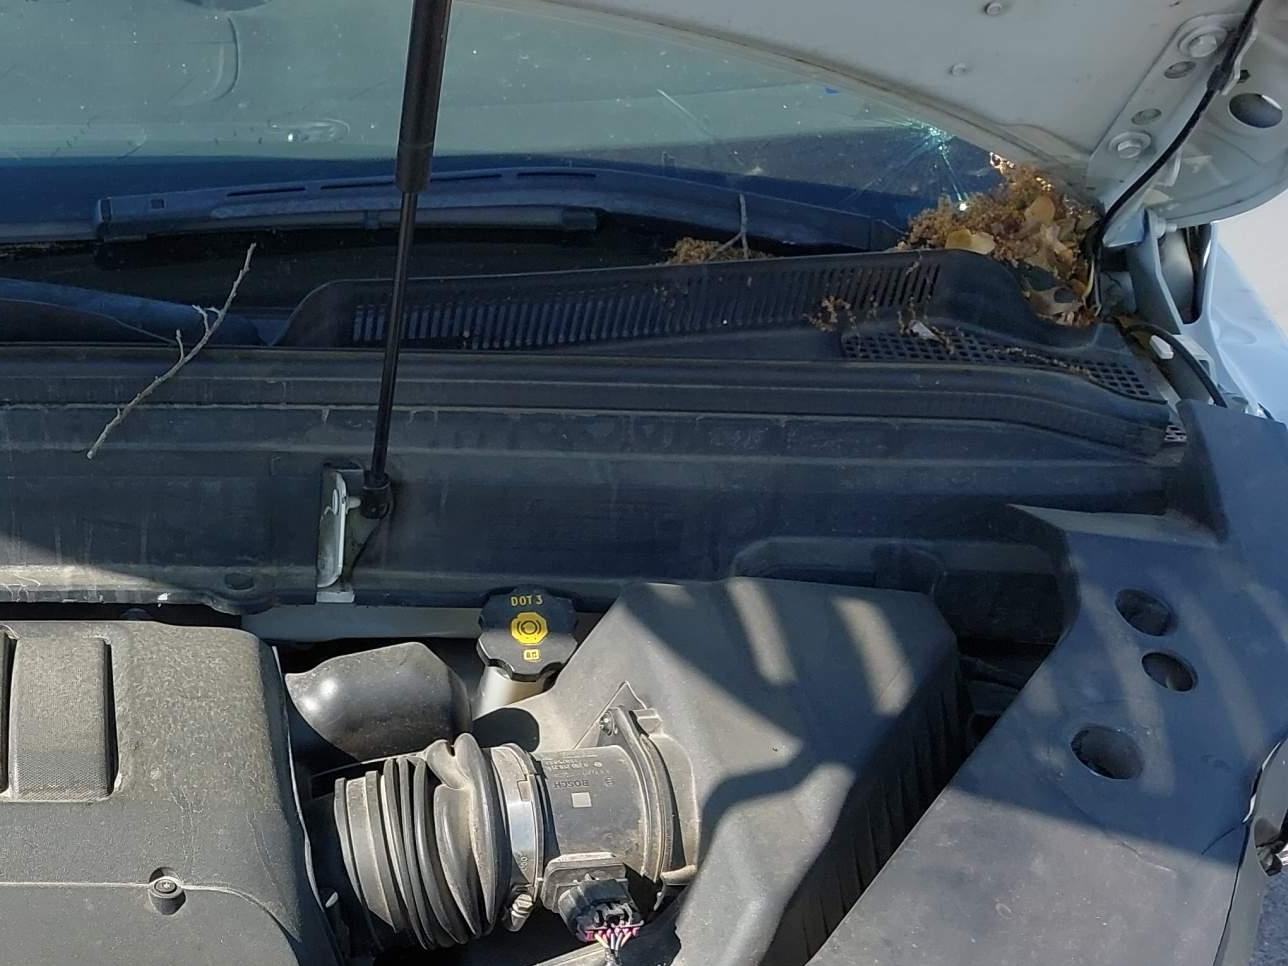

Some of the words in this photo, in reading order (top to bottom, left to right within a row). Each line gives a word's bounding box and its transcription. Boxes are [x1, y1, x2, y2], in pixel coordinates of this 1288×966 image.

[510, 595, 533, 607] DOT
[535, 594, 544, 605] 3
[553, 779, 590, 789] BOSCH
